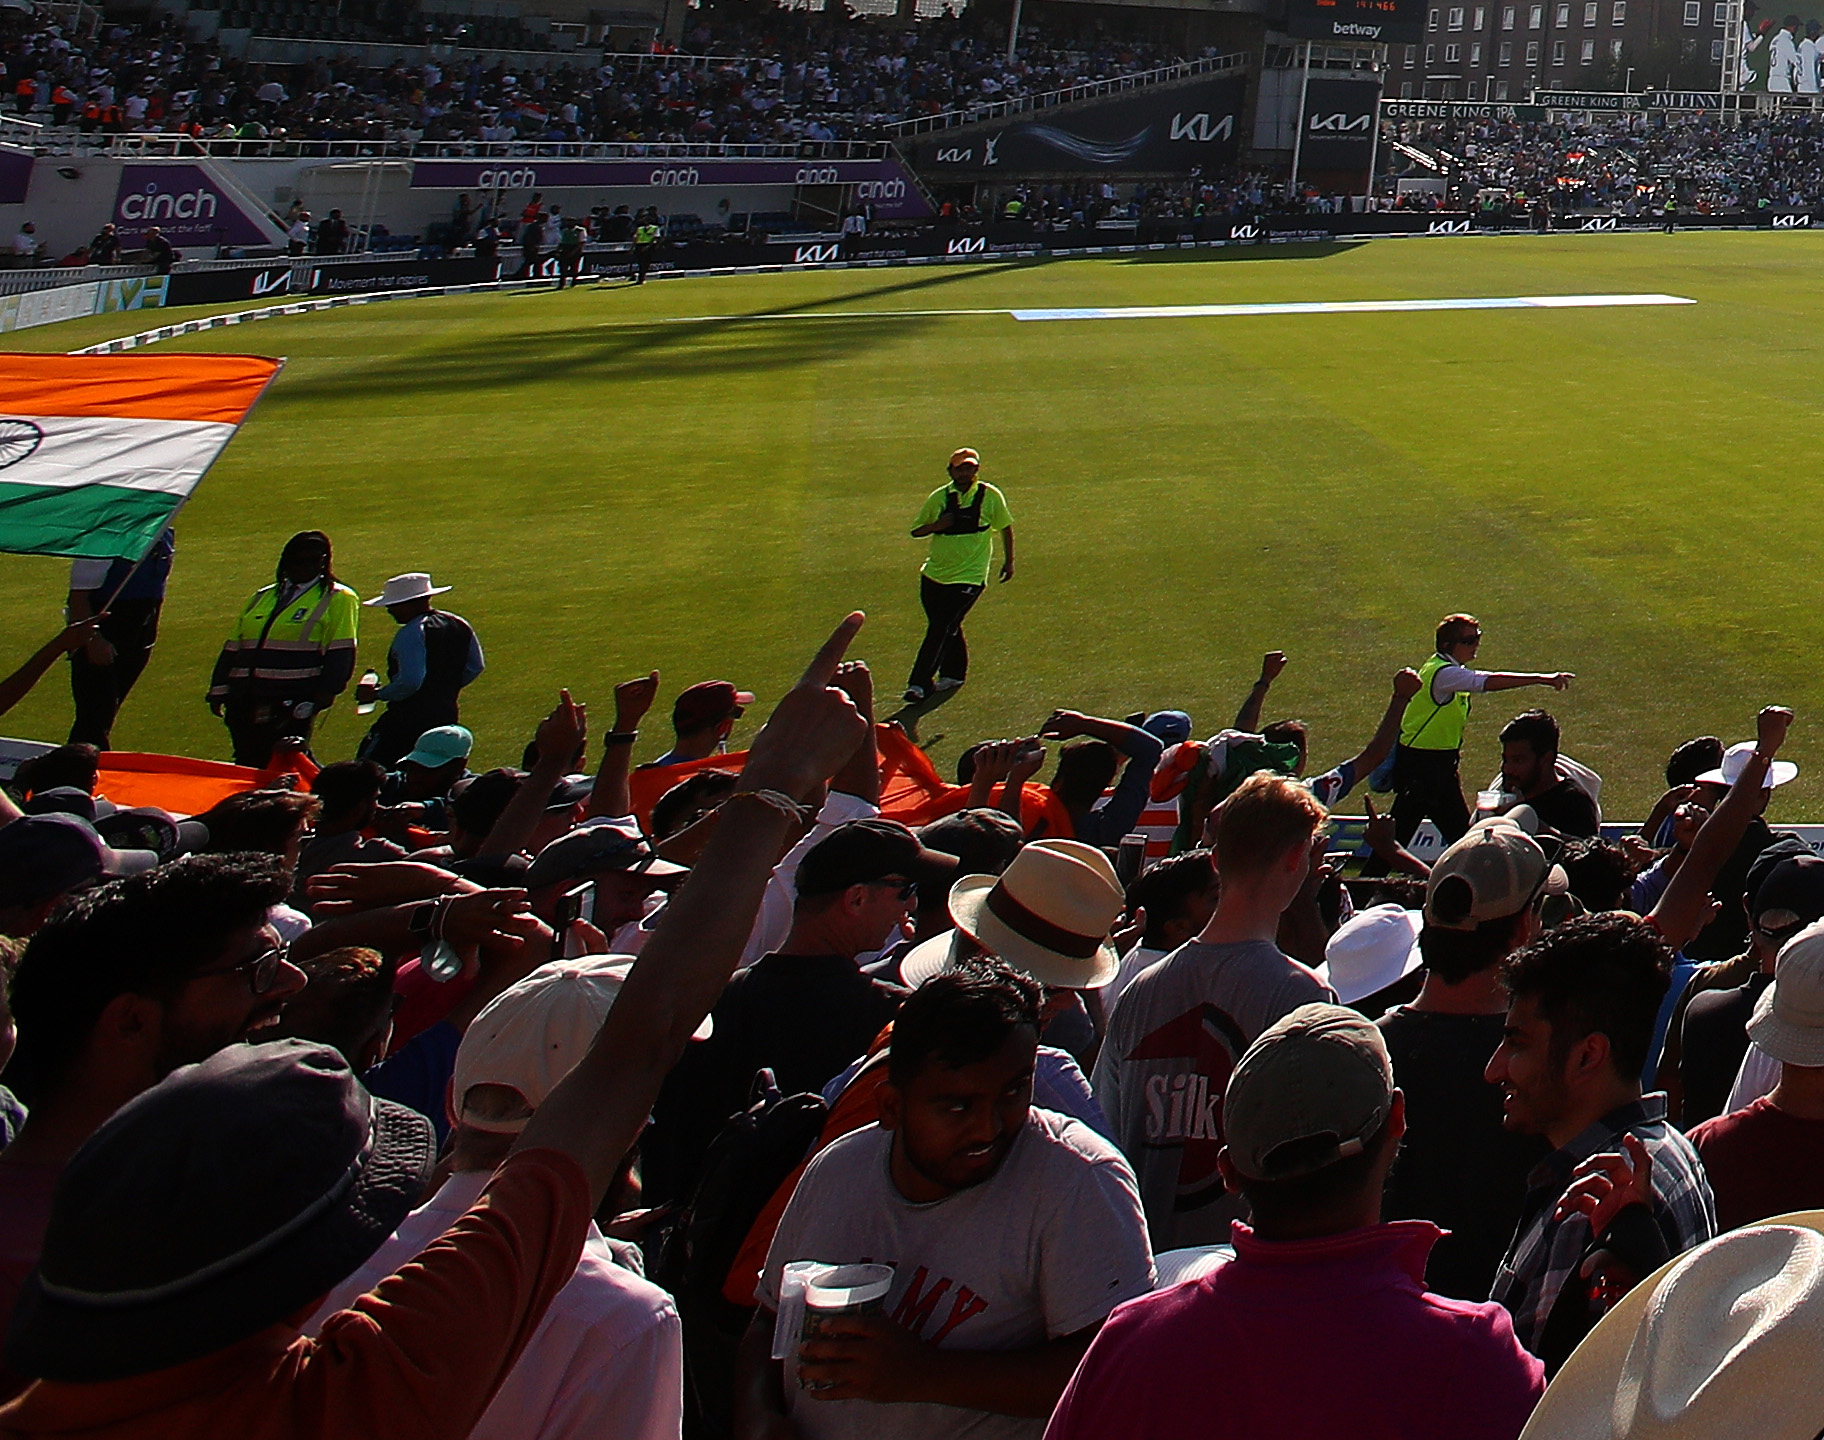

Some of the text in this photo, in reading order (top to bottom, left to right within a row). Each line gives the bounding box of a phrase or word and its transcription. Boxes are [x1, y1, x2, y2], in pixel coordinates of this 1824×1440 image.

[1333, 22, 1382, 38] betway
[1542, 94, 1641, 109] GREENE KING IPA
[1651, 93, 1718, 108] JM FINN
[1387, 103, 1517, 120] GREENE KING IPA
[1170, 112, 1233, 142] KIA
[1310, 113, 1371, 132] KIA
[936, 147, 972, 162] KIA
[479, 162, 536, 188] cinch
[650, 164, 698, 187] cinch
[796, 163, 838, 185] cinch
[858, 175, 905, 200] cinch
[121, 182, 217, 220] cinch
[795, 244, 839, 261] KIA
[947, 237, 986, 254] KIA
[328, 276, 375, 290] Movement
[1146, 1073, 1220, 1139] Silk
